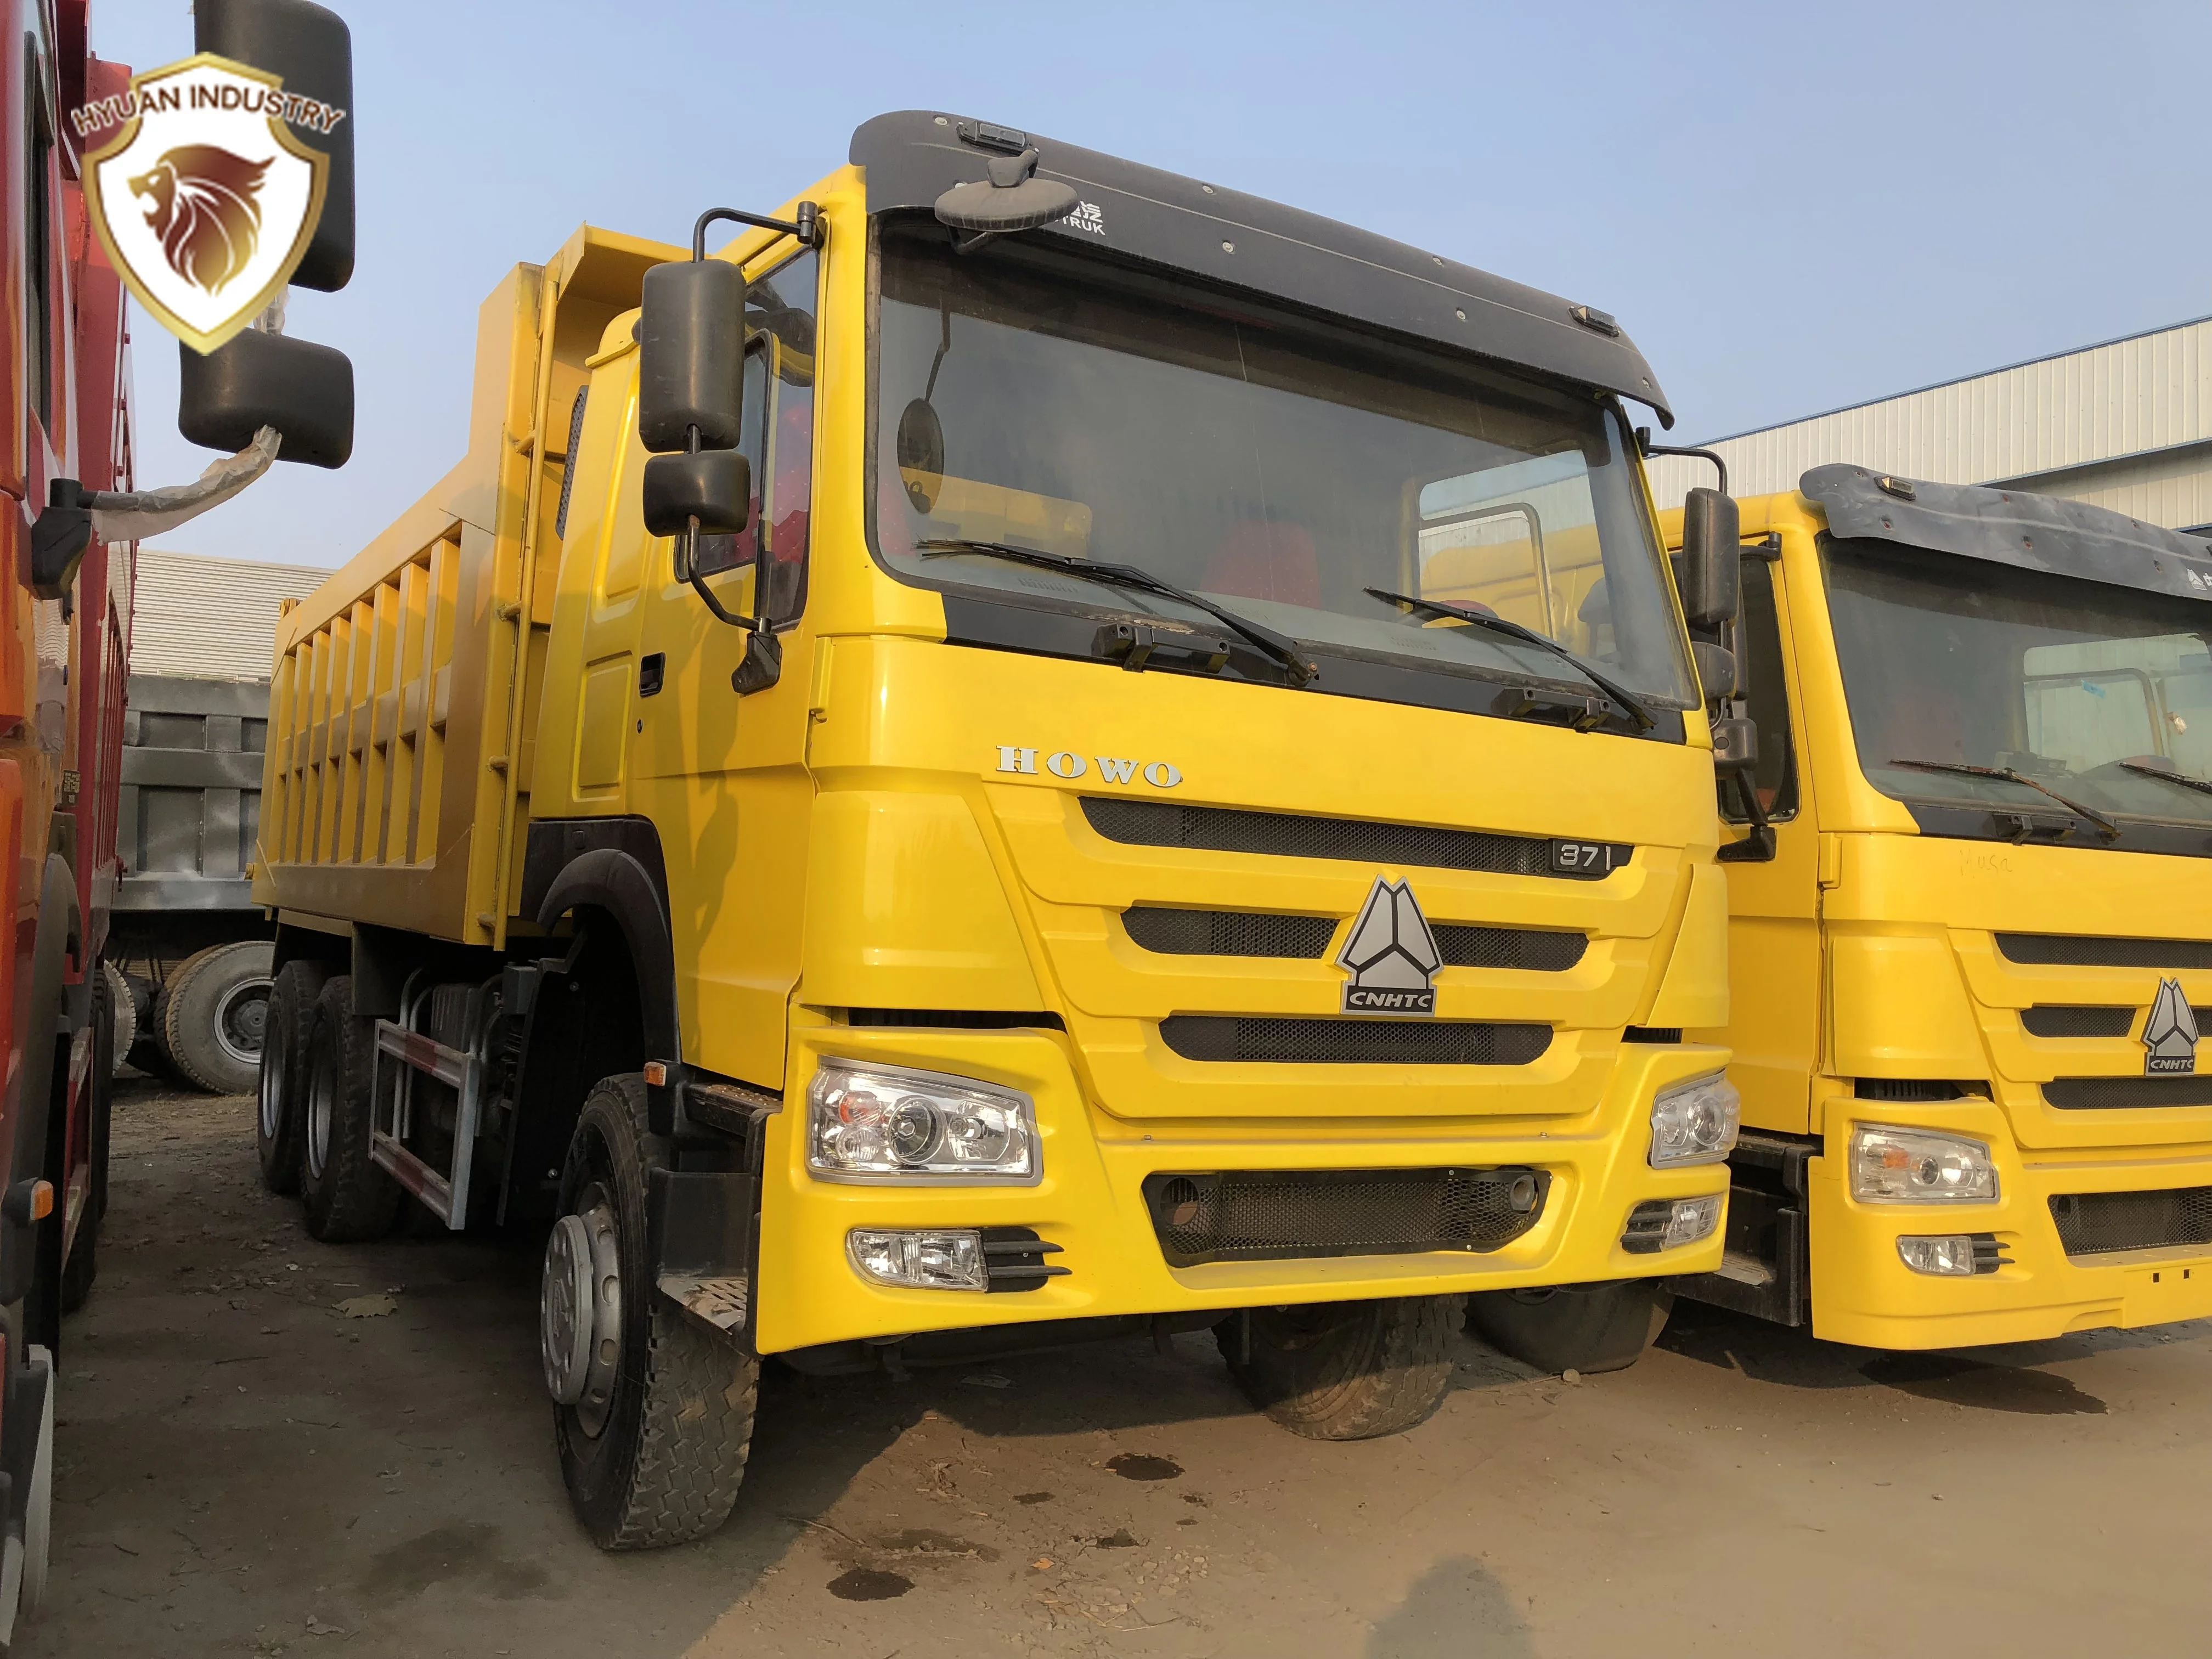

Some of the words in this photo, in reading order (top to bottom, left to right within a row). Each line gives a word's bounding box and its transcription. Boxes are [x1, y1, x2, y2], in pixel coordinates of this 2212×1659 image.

[1054, 216, 1105, 235] TRUK
[996, 746, 1182, 788] HOWO
[1560, 844, 1611, 871] 371
[1350, 992, 1431, 1008] CNHTC
[2151, 1059, 2193, 1069] CNHTC
